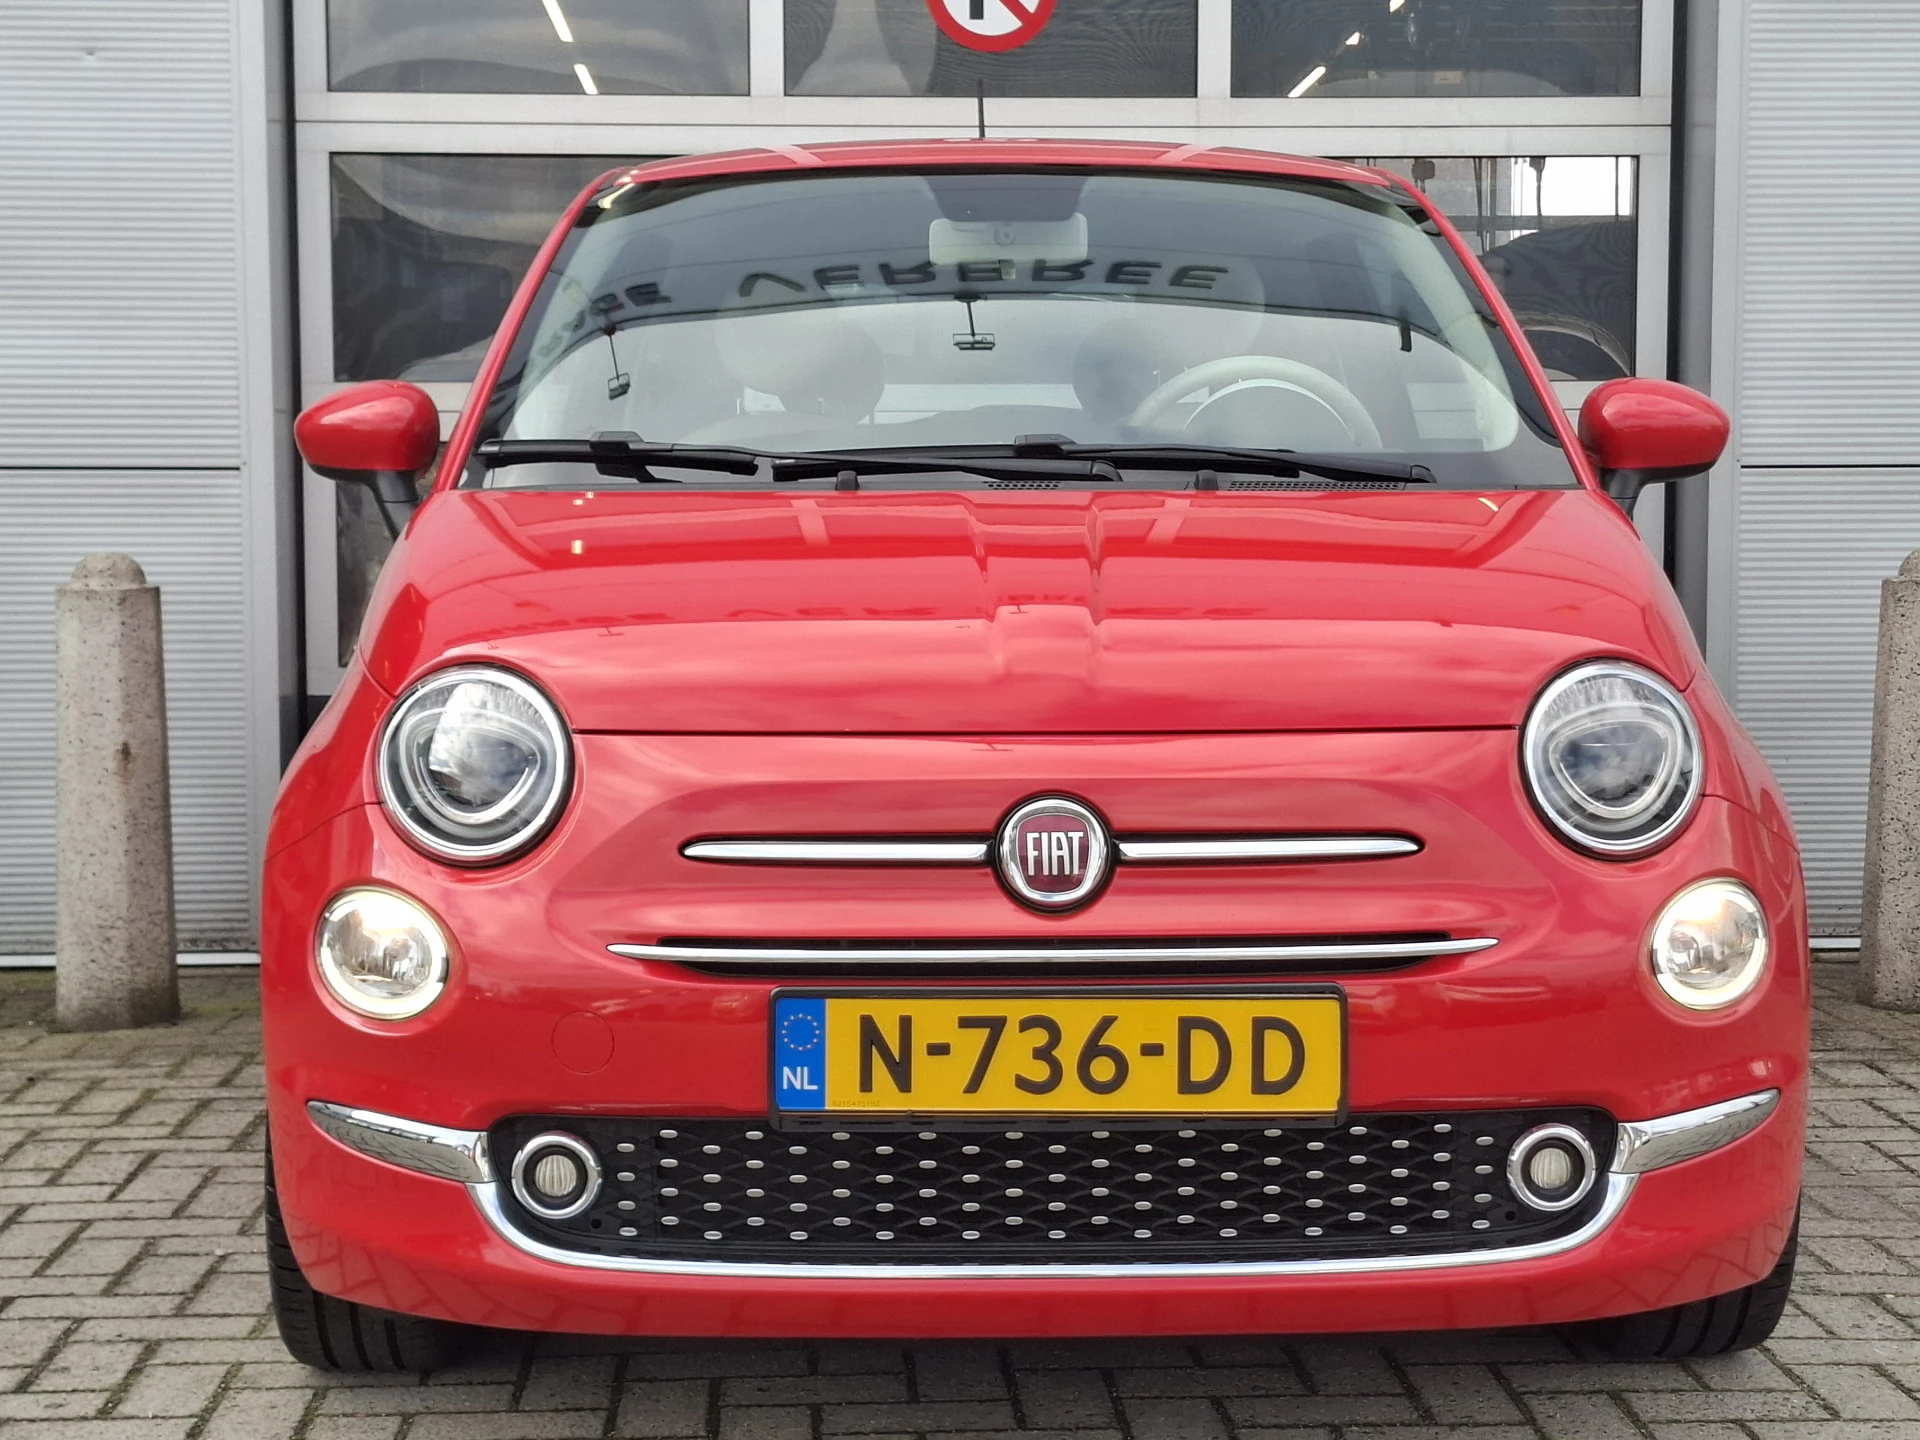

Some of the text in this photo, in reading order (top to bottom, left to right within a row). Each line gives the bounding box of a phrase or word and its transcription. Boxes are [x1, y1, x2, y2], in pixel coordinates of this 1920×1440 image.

[1026, 831, 1084, 876] FIAT
[858, 1014, 1306, 1096] N-736-DD
[782, 1066, 819, 1091] NL
